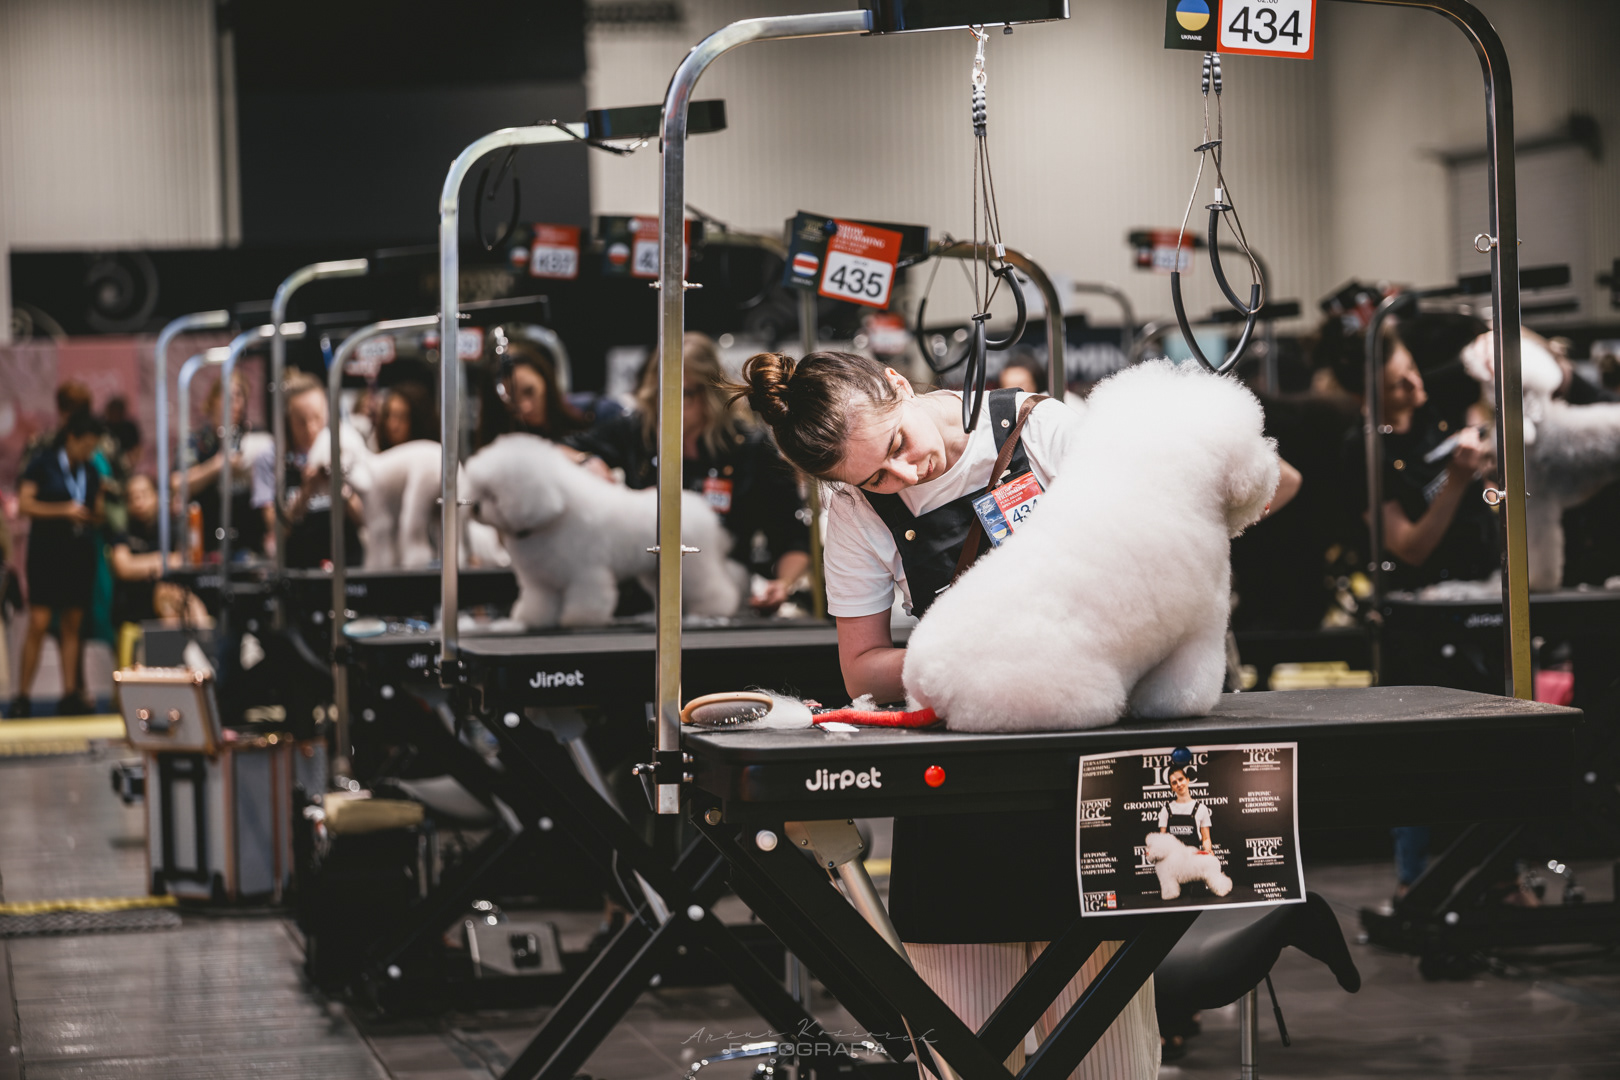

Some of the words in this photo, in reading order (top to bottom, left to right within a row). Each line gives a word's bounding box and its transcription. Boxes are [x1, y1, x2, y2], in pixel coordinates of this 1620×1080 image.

[1228, 6, 1303, 46] 434
[829, 264, 884, 298] 435
[1142, 753, 1208, 768] HYPIC
[1249, 752, 1275, 762] IGC
[1081, 807, 1106, 819] IGC
[1141, 811, 1159, 821] 202
[1246, 839, 1283, 848] HYPONIC
[1253, 846, 1277, 857] IGC
